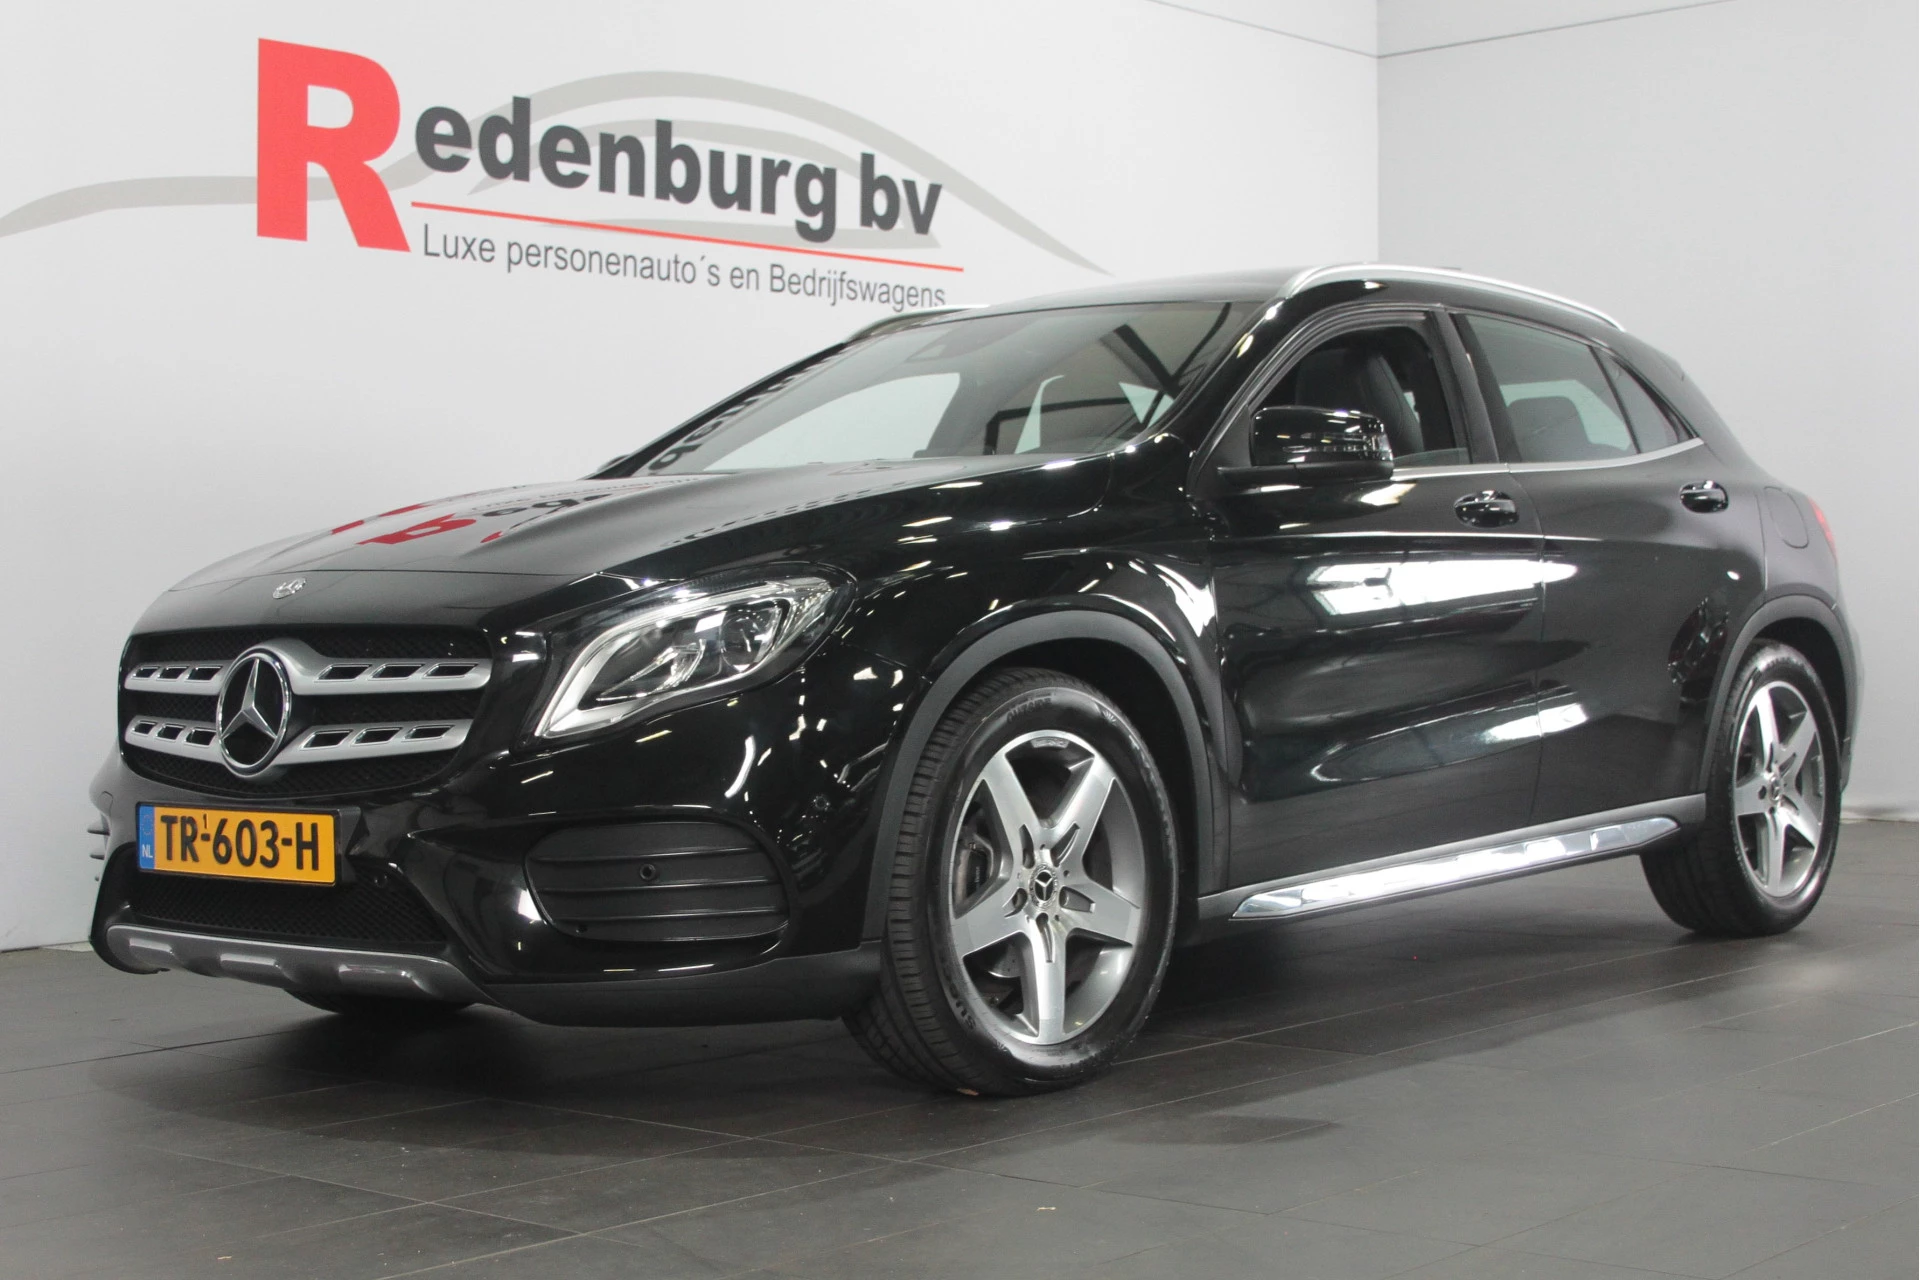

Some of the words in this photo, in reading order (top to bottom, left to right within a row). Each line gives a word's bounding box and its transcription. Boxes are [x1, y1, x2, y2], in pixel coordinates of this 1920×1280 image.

[257, 38, 837, 252] Redenburg
[861, 152, 942, 235] bv
[423, 223, 496, 263] Luxe
[729, 265, 760, 291] en
[769, 263, 946, 312] Bedrijfswagens
[141, 843, 153, 858] NL
[160, 814, 319, 871] TR-603-H
